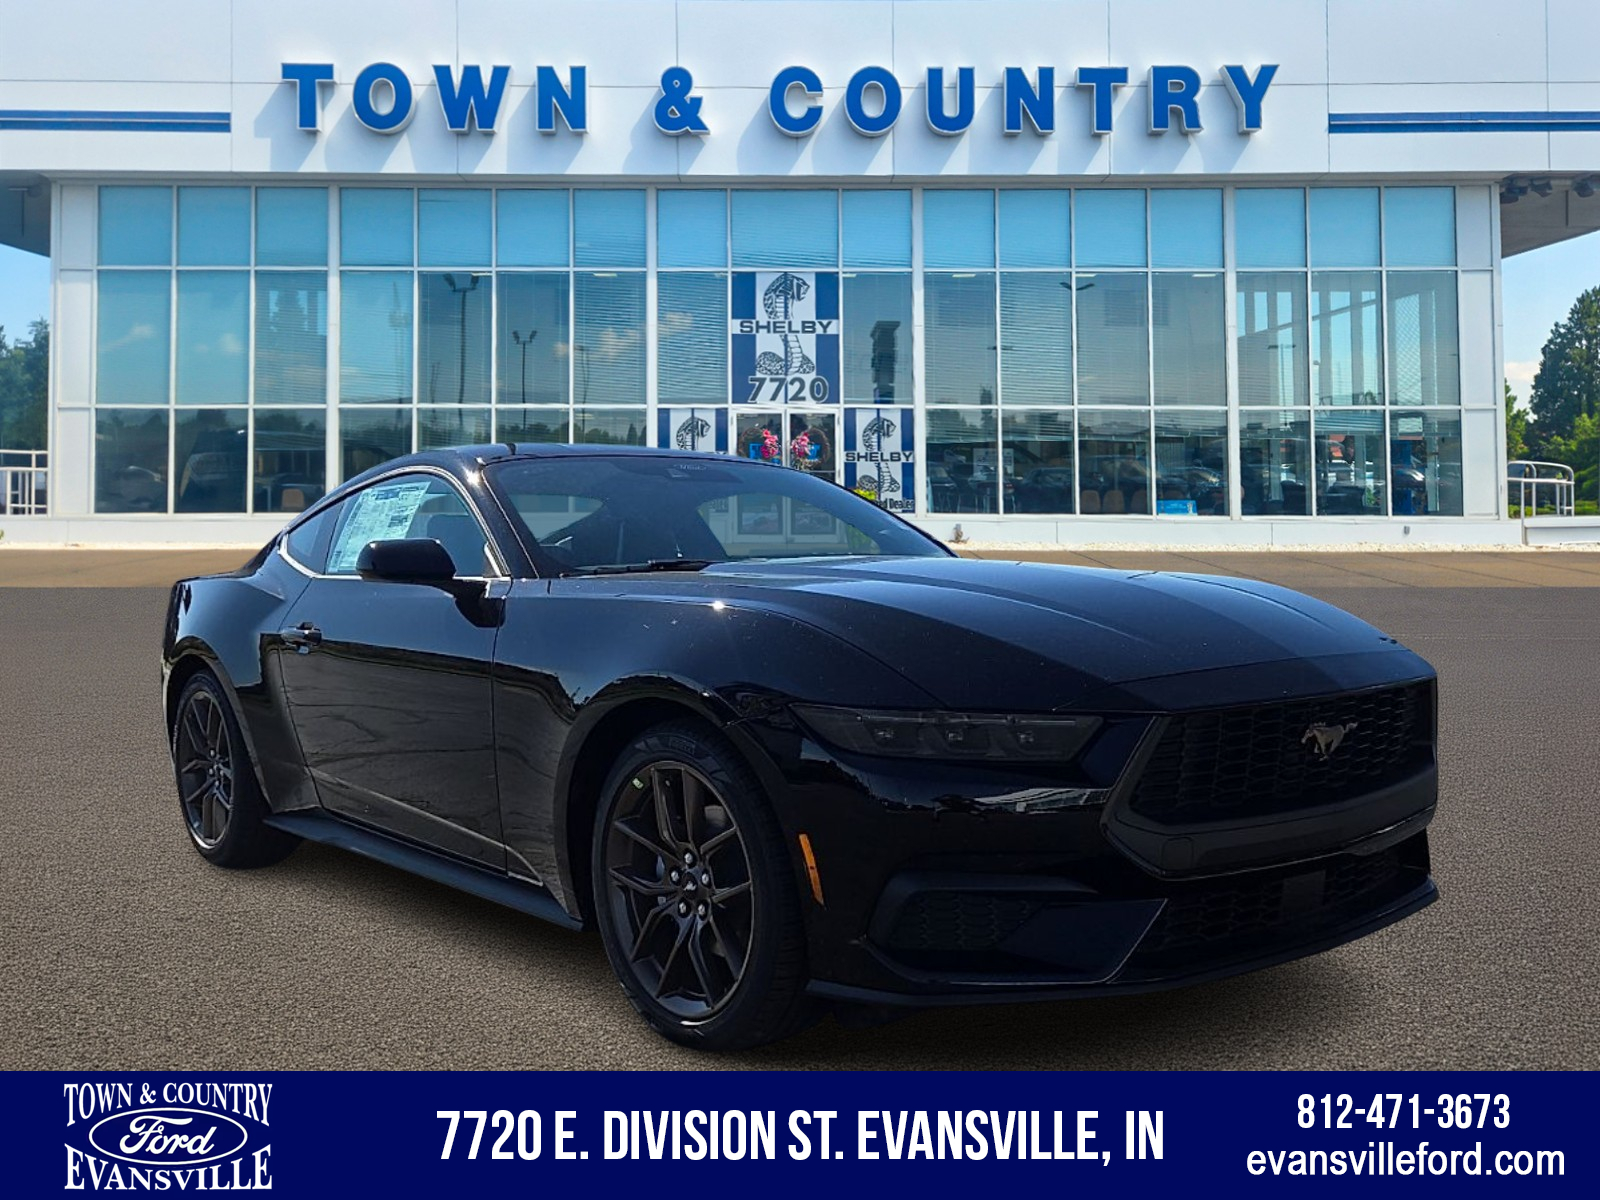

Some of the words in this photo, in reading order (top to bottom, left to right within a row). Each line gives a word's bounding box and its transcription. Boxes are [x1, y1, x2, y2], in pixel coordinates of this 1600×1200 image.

[282, 64, 588, 133] TOWN
[654, 67, 709, 134] &
[770, 65, 1279, 134] COUNTRY
[739, 319, 833, 335] SHELBY
[747, 375, 829, 404] 7720
[845, 451, 914, 463] SHELBY
[889, 498, 914, 510] Dealer
